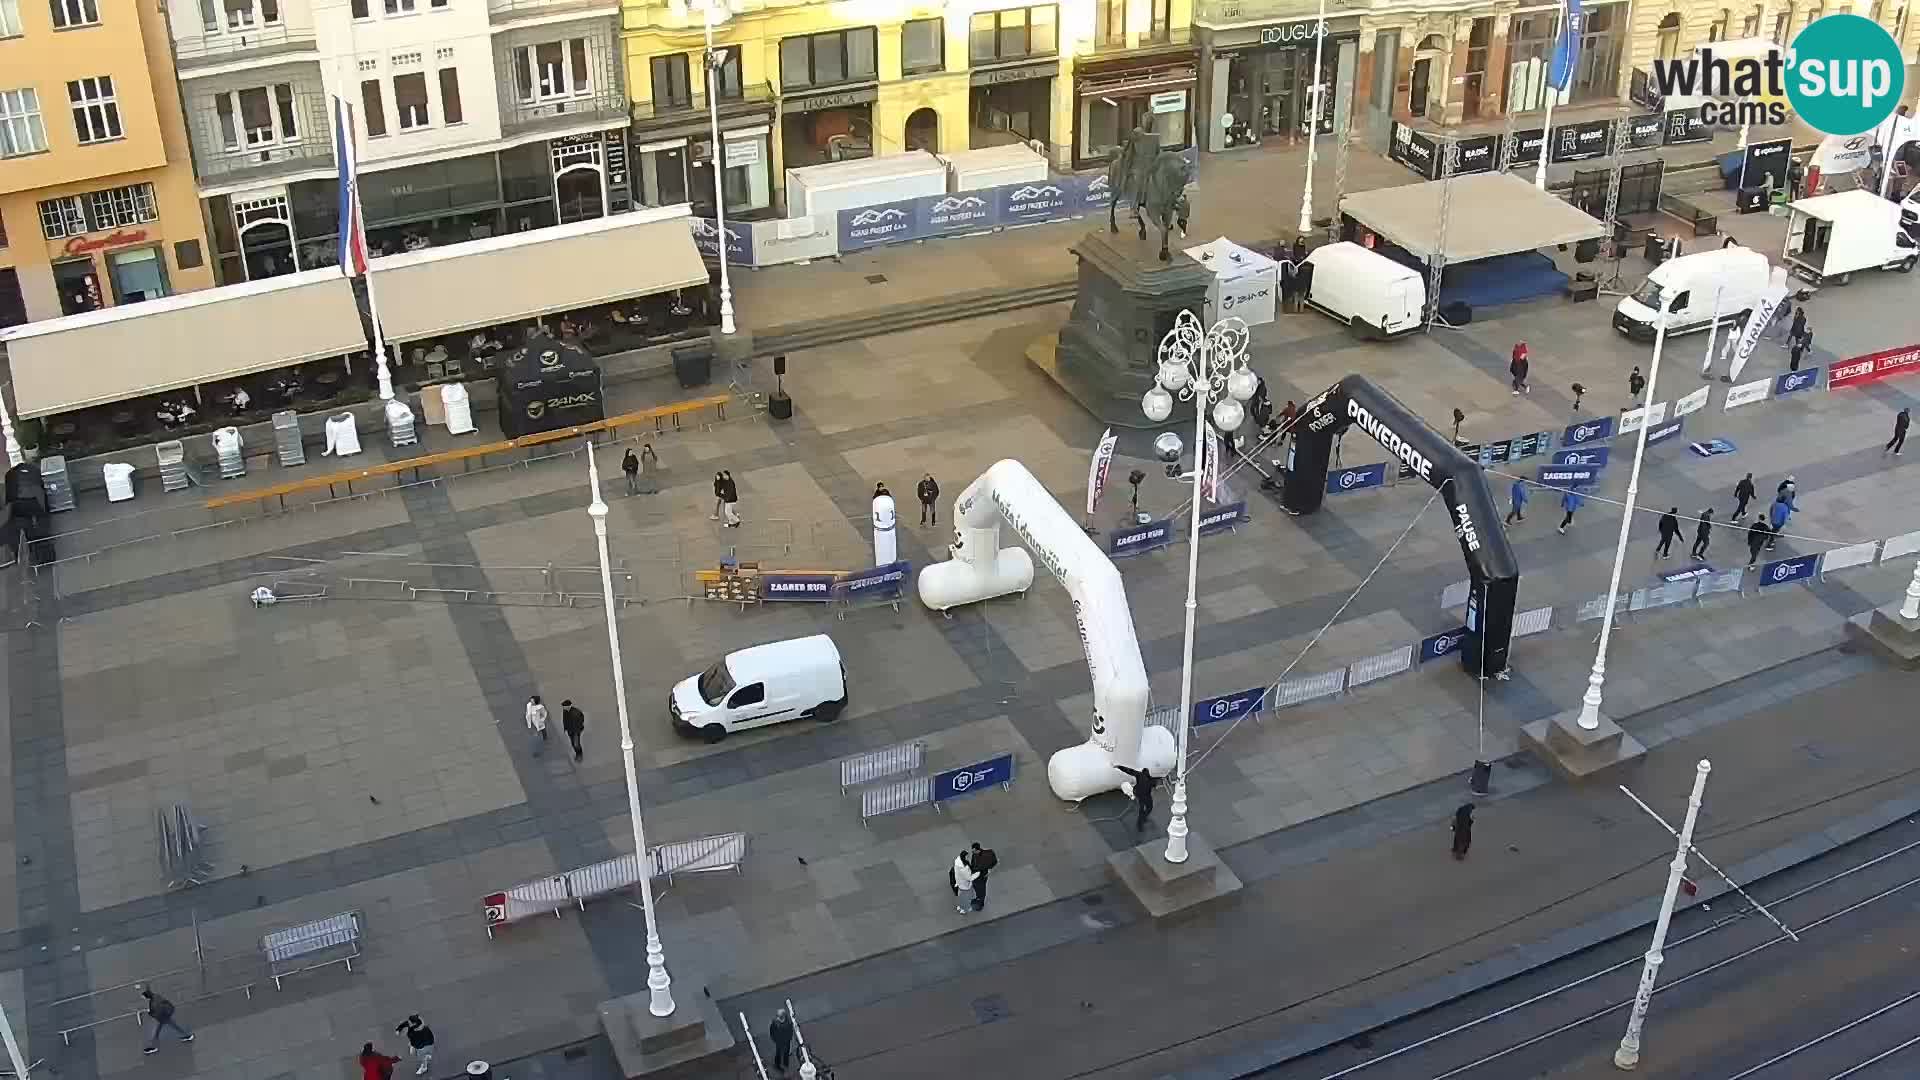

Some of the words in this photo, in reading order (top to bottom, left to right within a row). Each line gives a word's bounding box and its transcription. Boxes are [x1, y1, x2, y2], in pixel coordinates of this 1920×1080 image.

[1261, 21, 1329, 44] DOUGLAS
[1739, 300, 1773, 358] GARMIN
[1347, 399, 1433, 482] POWERADE
[1455, 503, 1480, 552] PAUSE
